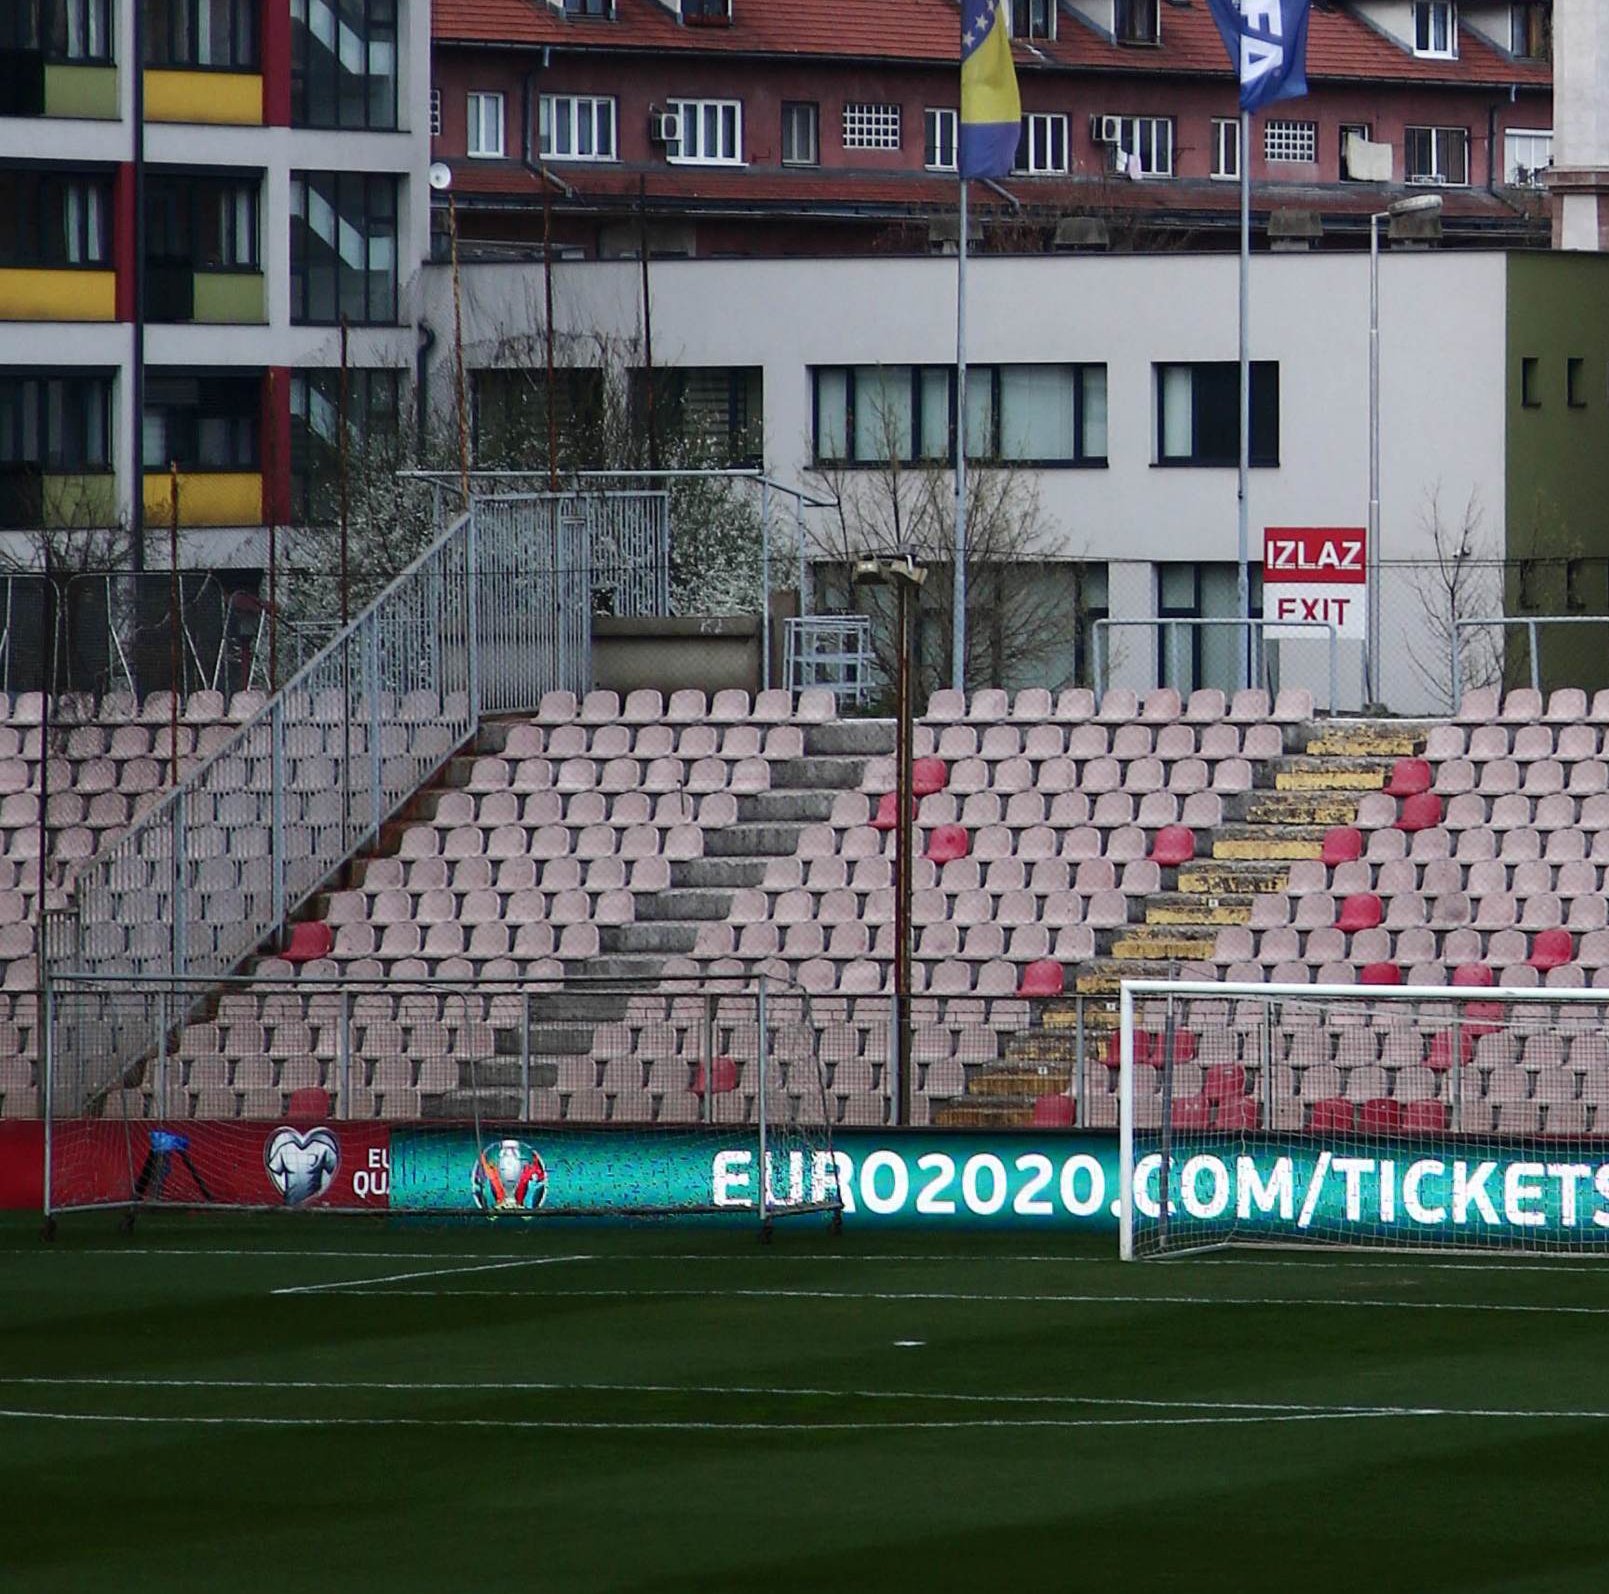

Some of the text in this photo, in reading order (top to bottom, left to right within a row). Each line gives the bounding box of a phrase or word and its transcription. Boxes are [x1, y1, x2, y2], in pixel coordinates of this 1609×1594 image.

[1266, 540, 1362, 570] IZLAZ
[1277, 598, 1351, 625] EXIT
[353, 1170, 390, 1199] QU
